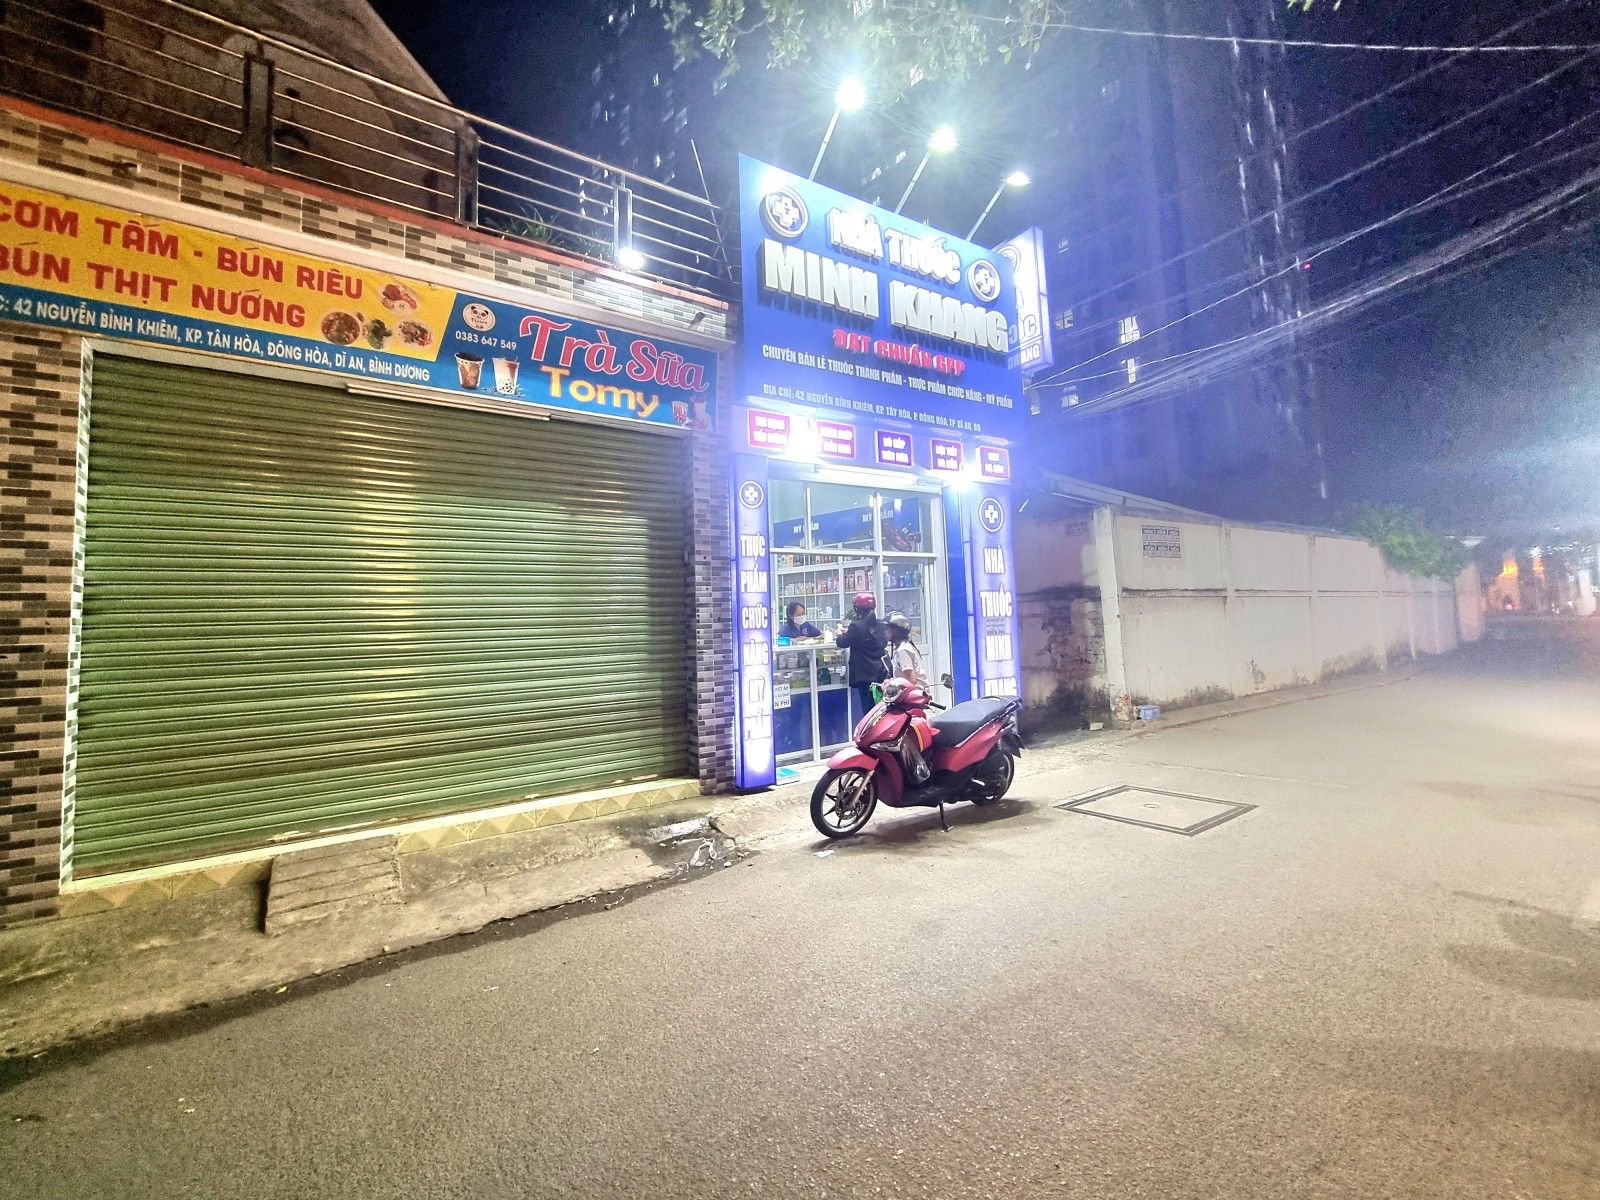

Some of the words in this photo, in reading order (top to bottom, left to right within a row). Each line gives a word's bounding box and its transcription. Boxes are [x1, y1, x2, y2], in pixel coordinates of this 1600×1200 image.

[95, 218, 179, 260] TẤM
[217, 246, 284, 284] BÚN
[296, 265, 363, 300] RIÊU
[86, 261, 178, 304] THỊT
[191, 284, 306, 328] NƯỚNG
[763, 239, 879, 320] MINH
[889, 280, 1009, 353] KHANG
[13, 298, 32, 316] 42
[37, 301, 96, 326] NGUYỄN
[137, 318, 181, 343] KHIÊM,
[185, 327, 203, 344] KP.
[207, 329, 231, 349] TÂN
[234, 334, 264, 356] HÒA,
[267, 340, 302, 360] ĐÔNG
[305, 346, 332, 368] HÒA,
[348, 356, 366, 373] AN,
[368, 356, 392, 376] BÌNH
[394, 363, 430, 381] DƯƠNG
[455, 330, 479, 343] 0383
[481, 335, 498, 347] 647
[500, 339, 517, 351] 549
[519, 315, 623, 375] Trà
[626, 339, 710, 392] Sữa
[540, 364, 660, 418] Tomy
[762, 344, 796, 363] CHUYÊN
[798, 352, 816, 368] BÁN
[817, 354, 826, 370] LẺ
[828, 359, 854, 376] THUỐC
[908, 377, 926, 391] THỰC
[740, 533, 766, 560] THỰC
[984, 545, 1005, 574] NHÀ
[742, 603, 768, 629] CHỨC
[980, 583, 1013, 618] THUỐC
